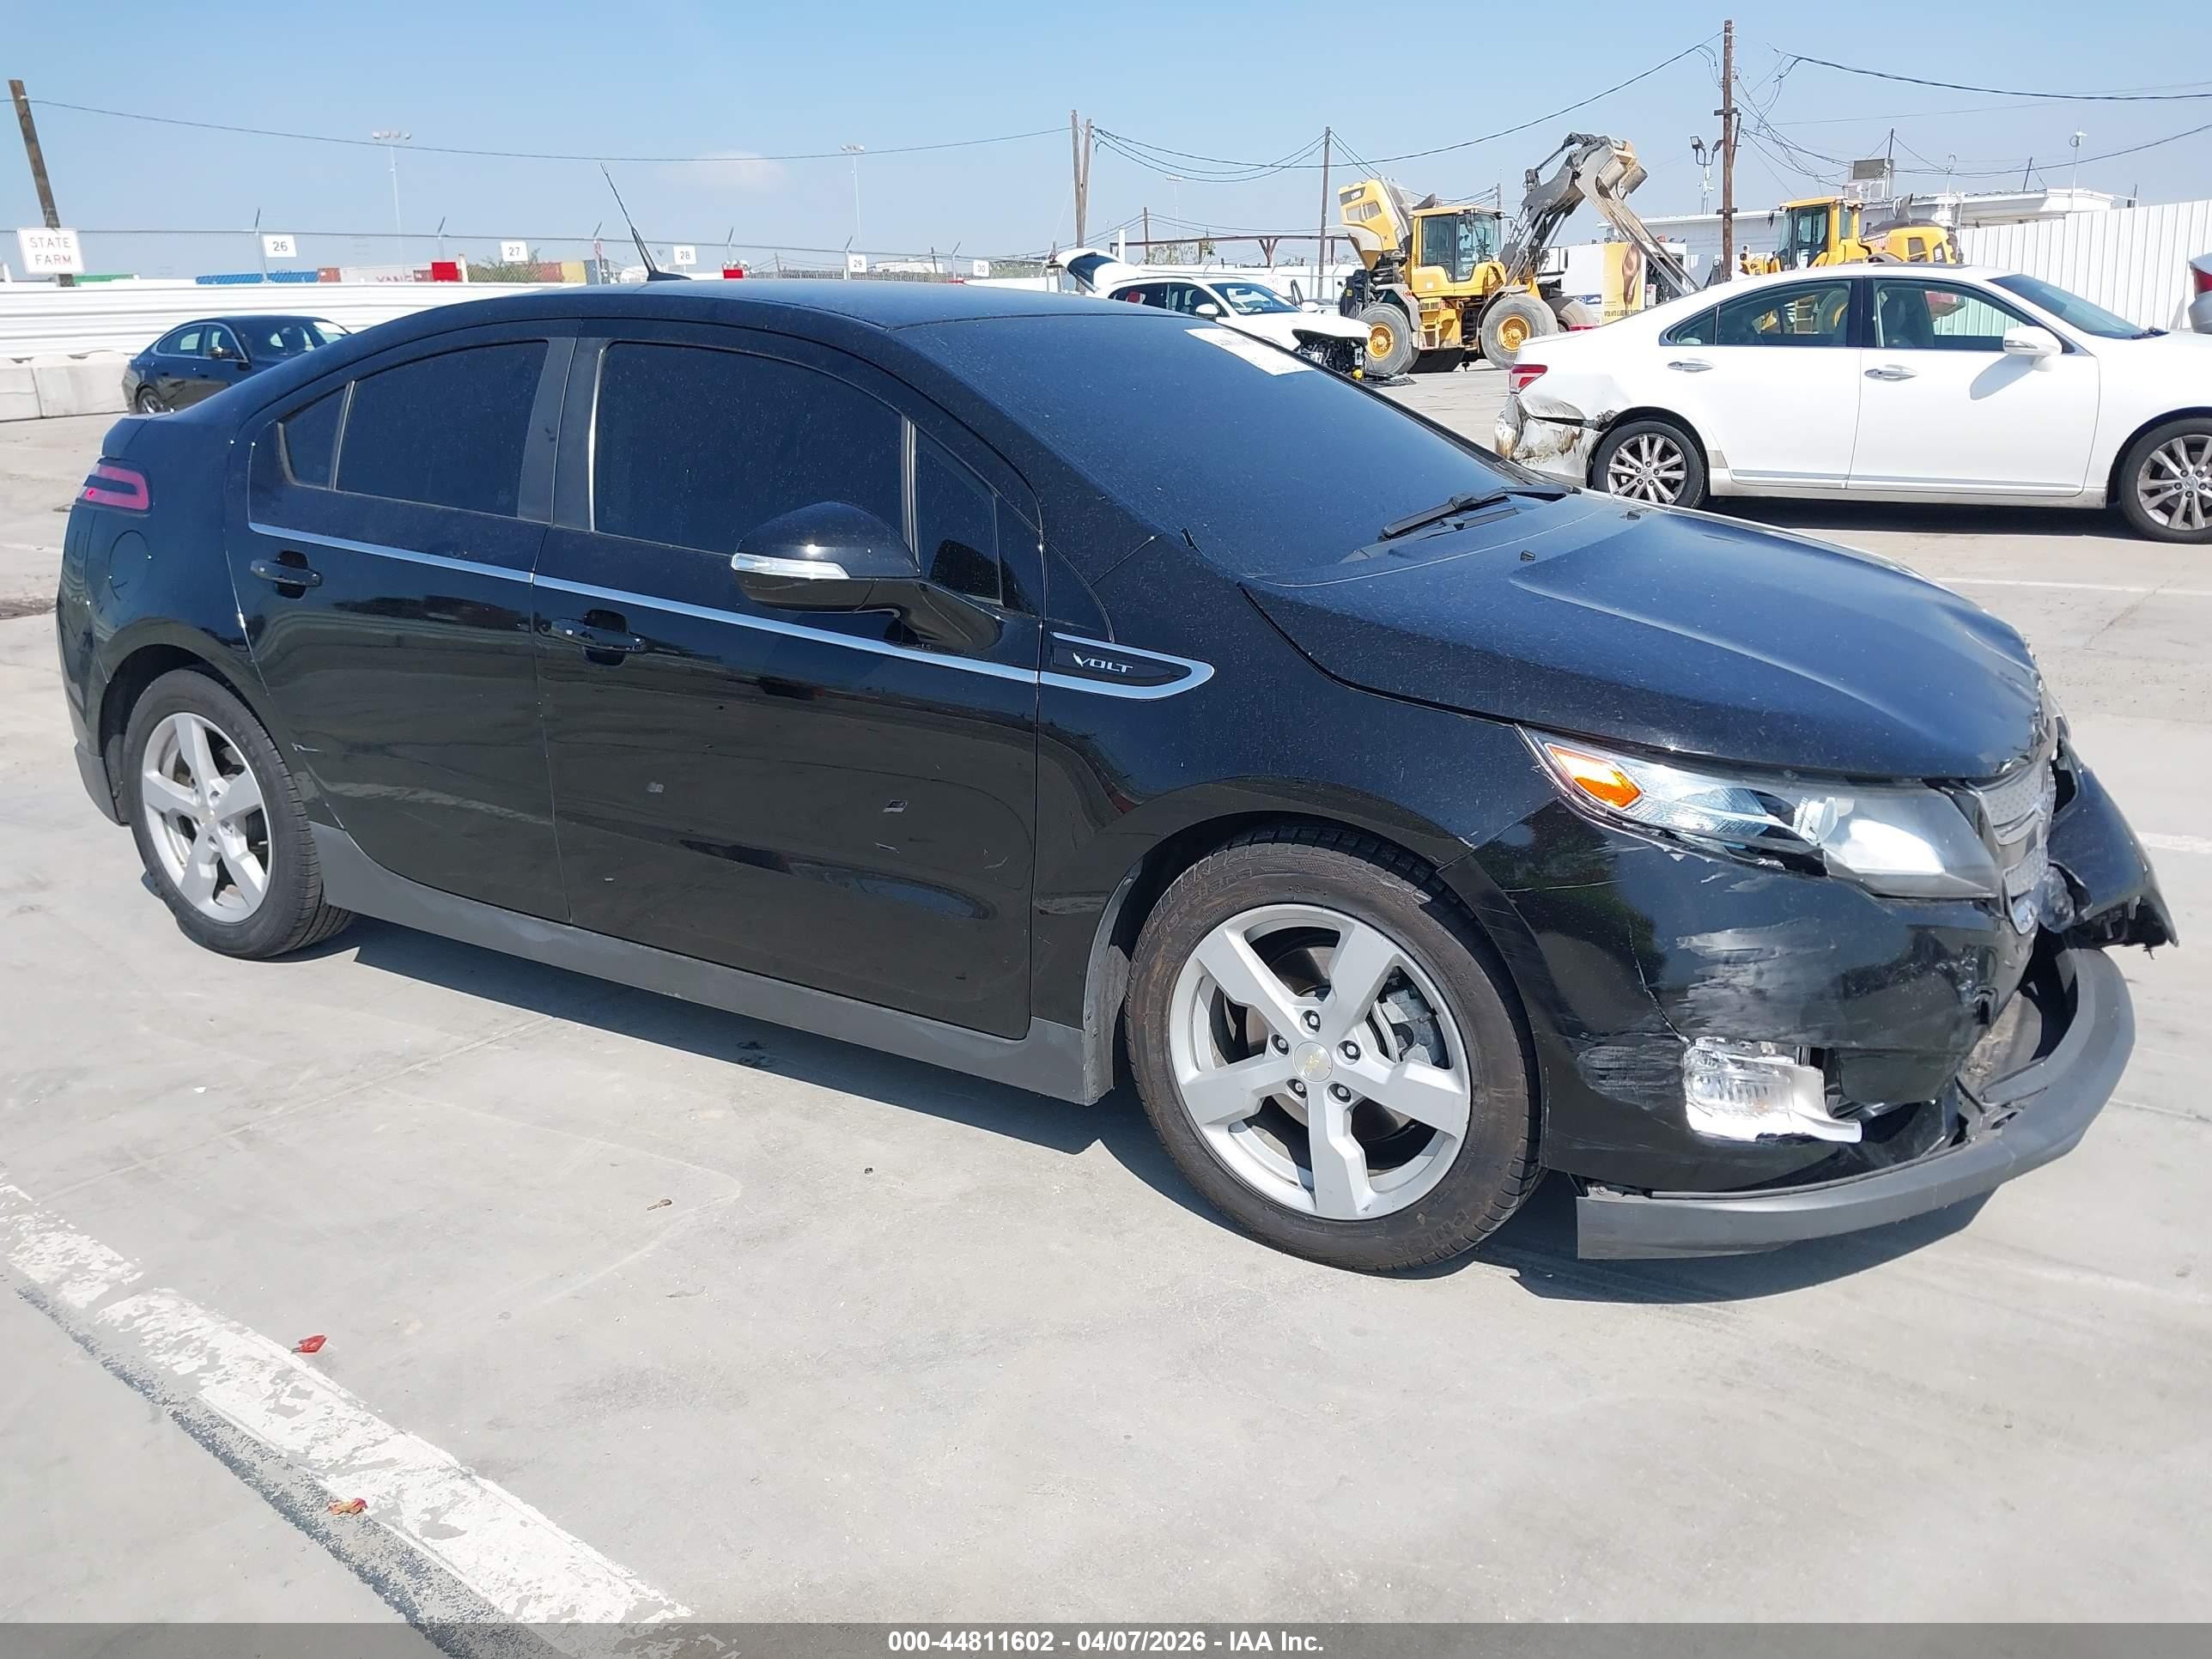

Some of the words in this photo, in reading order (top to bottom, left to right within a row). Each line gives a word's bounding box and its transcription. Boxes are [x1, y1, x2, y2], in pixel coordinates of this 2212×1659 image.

[28, 237, 71, 248] STATE
[272, 240, 289, 252] 26
[508, 246, 520, 257] 27
[679, 251, 691, 260] 28
[34, 254, 72, 265] FARM
[854, 259, 862, 268] 29
[1073, 652, 1133, 673] VOLT
